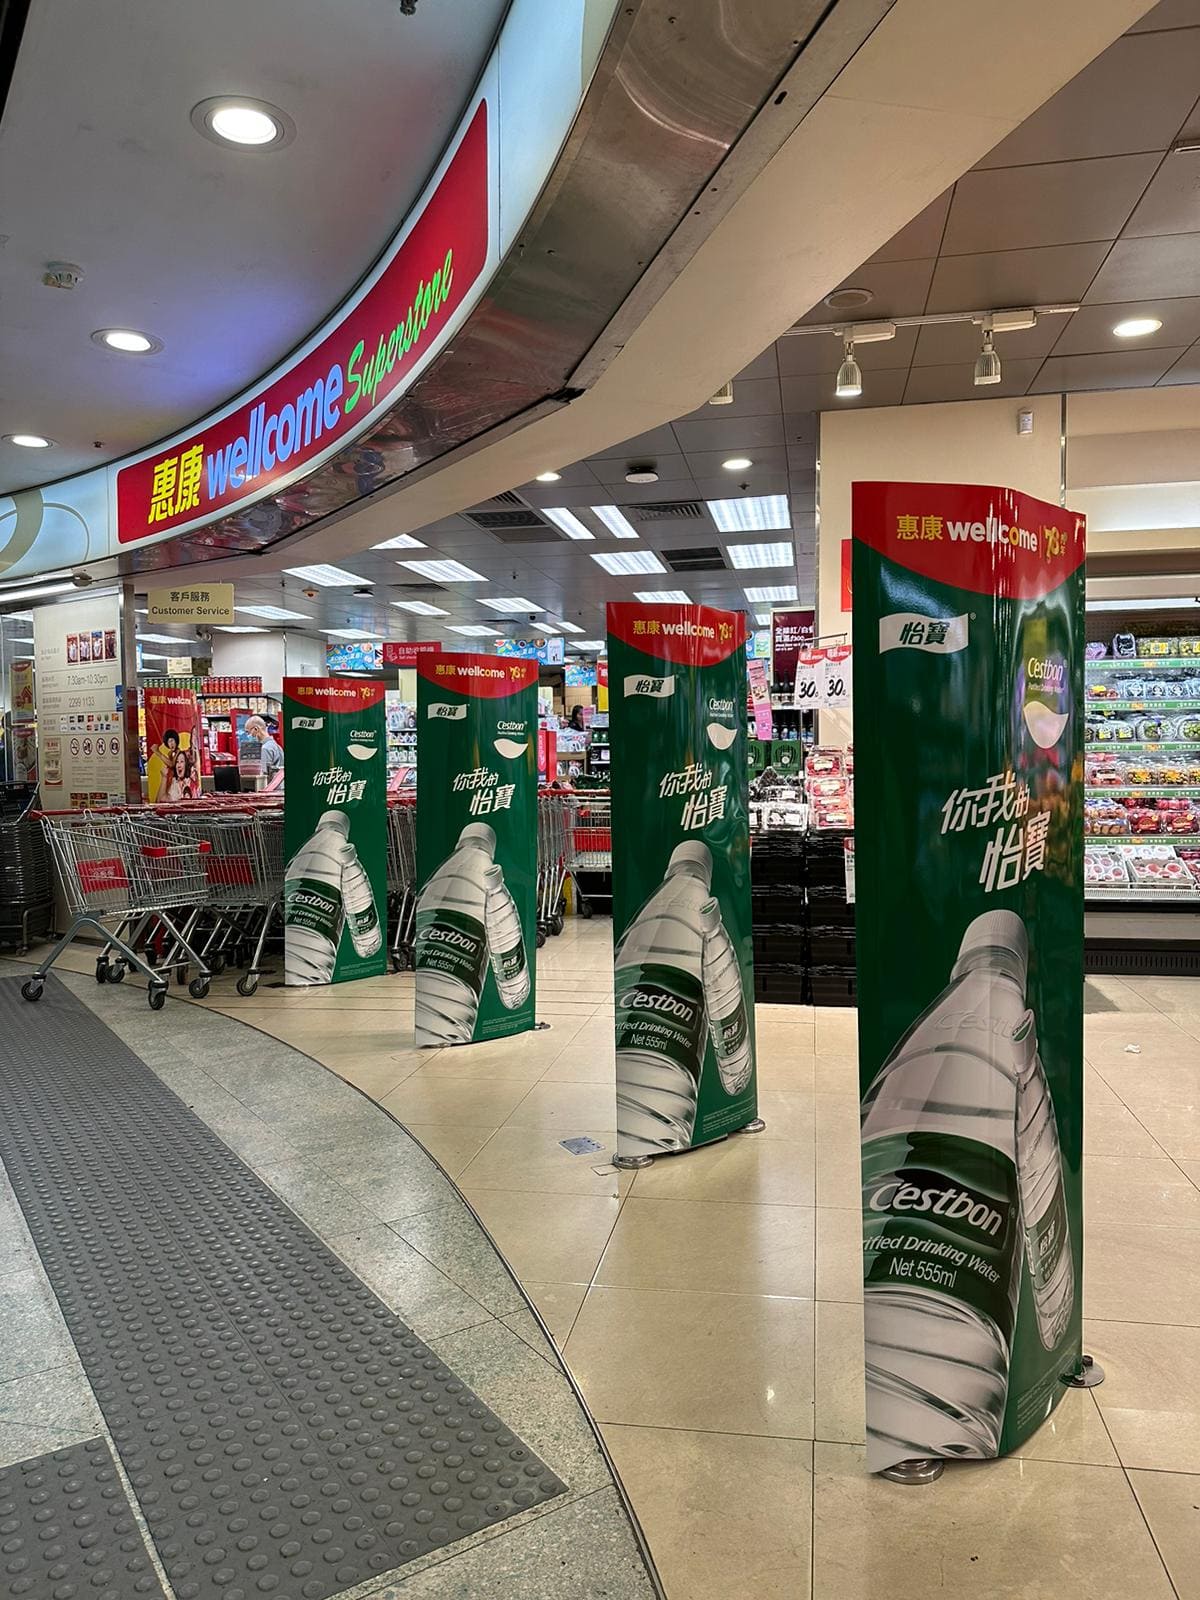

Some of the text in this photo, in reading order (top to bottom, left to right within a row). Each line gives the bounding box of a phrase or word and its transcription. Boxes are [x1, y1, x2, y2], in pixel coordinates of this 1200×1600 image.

[148, 249, 454, 524] 惠康 wellcome Superstore
[896, 514, 943, 540] 惠康
[946, 517, 1038, 552] wellcome
[170, 591, 210, 602] 客戶服務
[151, 606, 230, 615] Customer Service
[633, 620, 661, 635] 惠康
[661, 621, 715, 639] wellcome
[899, 621, 950, 646] 怡寶
[435, 664, 457, 676] 惠康
[457, 665, 506, 679] wellcome
[314, 687, 357, 697] wellcome
[635, 679, 665, 694] 怡寶
[436, 707, 459, 717] 怡寶
[312, 766, 353, 787] 你我的
[452, 766, 500, 792] 你我的
[659, 762, 713, 798] 你我的
[326, 779, 368, 805] 怡寶
[469, 783, 516, 816] 怡寶
[941, 770, 1031, 835] 你我的
[680, 785, 728, 831] 怡寶
[978, 810, 1052, 893] 怡寶
[903, 1235, 969, 1267] Drinking
[967, 1254, 1001, 1284] Water
[888, 1257, 958, 1289] Net 555ml
